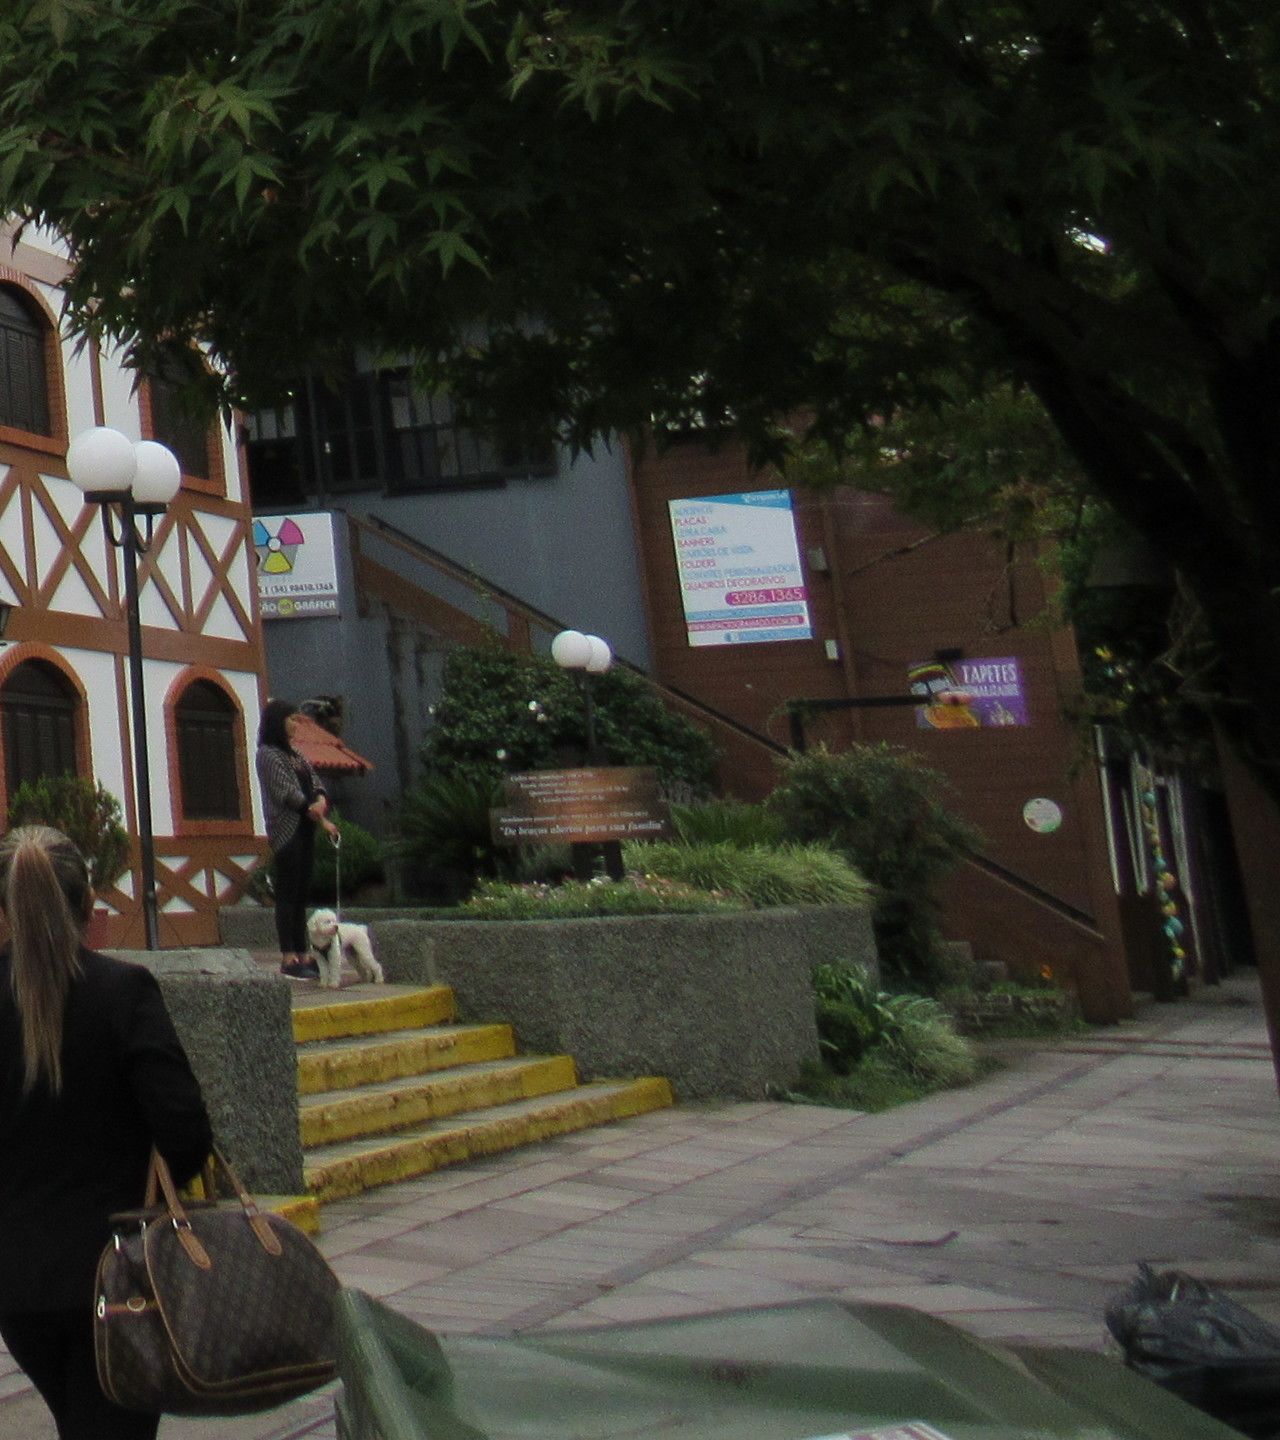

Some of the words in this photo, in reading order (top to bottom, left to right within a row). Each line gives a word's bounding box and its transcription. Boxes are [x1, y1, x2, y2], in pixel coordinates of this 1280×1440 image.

[675, 516, 708, 527] PLACAS
[678, 536, 715, 549] BANNERS
[681, 559, 716, 570] FOLDERS
[683, 579, 725, 591] QUADROS
[726, 575, 786, 588] DECORATIVOS
[731, 587, 803, 605] 3286.1365
[961, 663, 1017, 684] TAPETES
